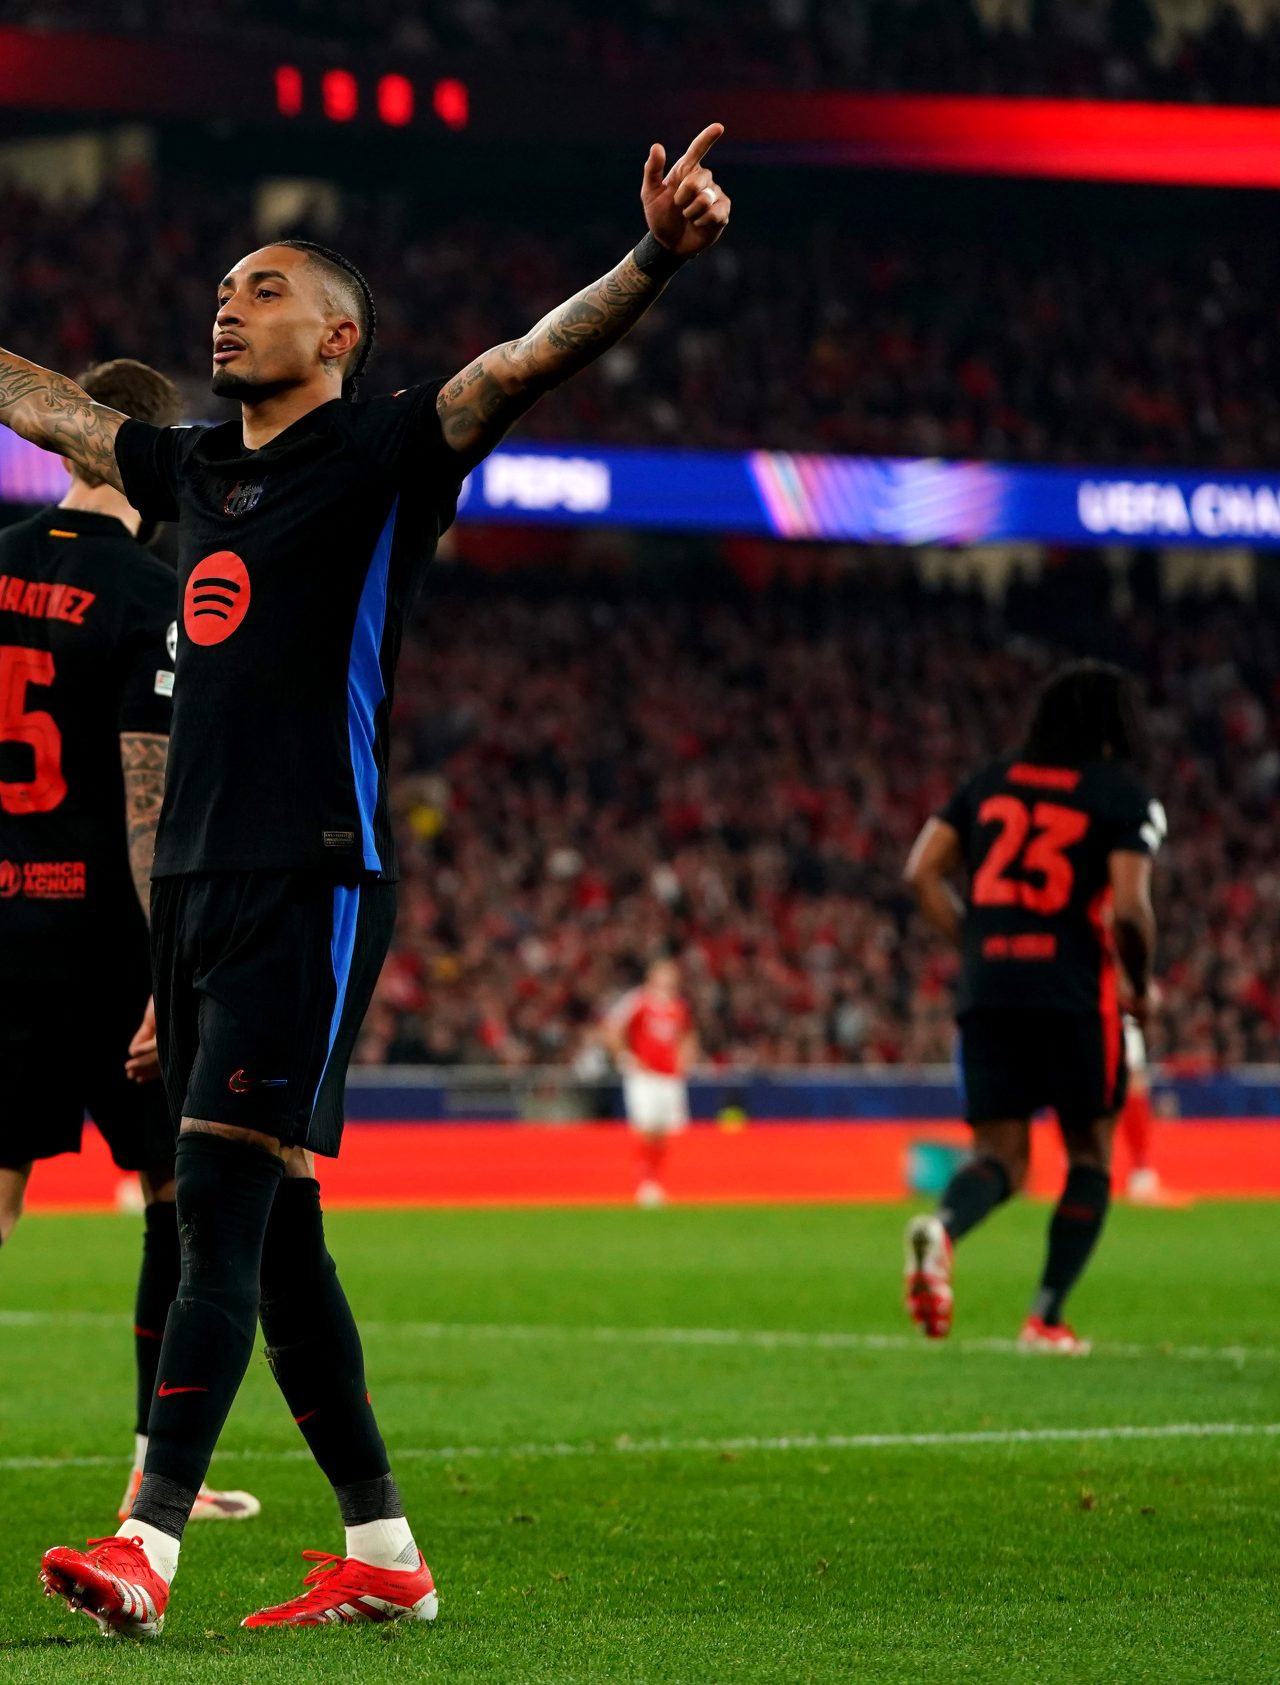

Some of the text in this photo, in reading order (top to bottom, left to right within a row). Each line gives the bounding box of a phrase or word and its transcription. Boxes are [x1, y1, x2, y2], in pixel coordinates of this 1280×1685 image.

[484, 454, 611, 513] PEPSI
[1077, 480, 1280, 539] UEFA CHA
[973, 795, 1089, 916] 23
